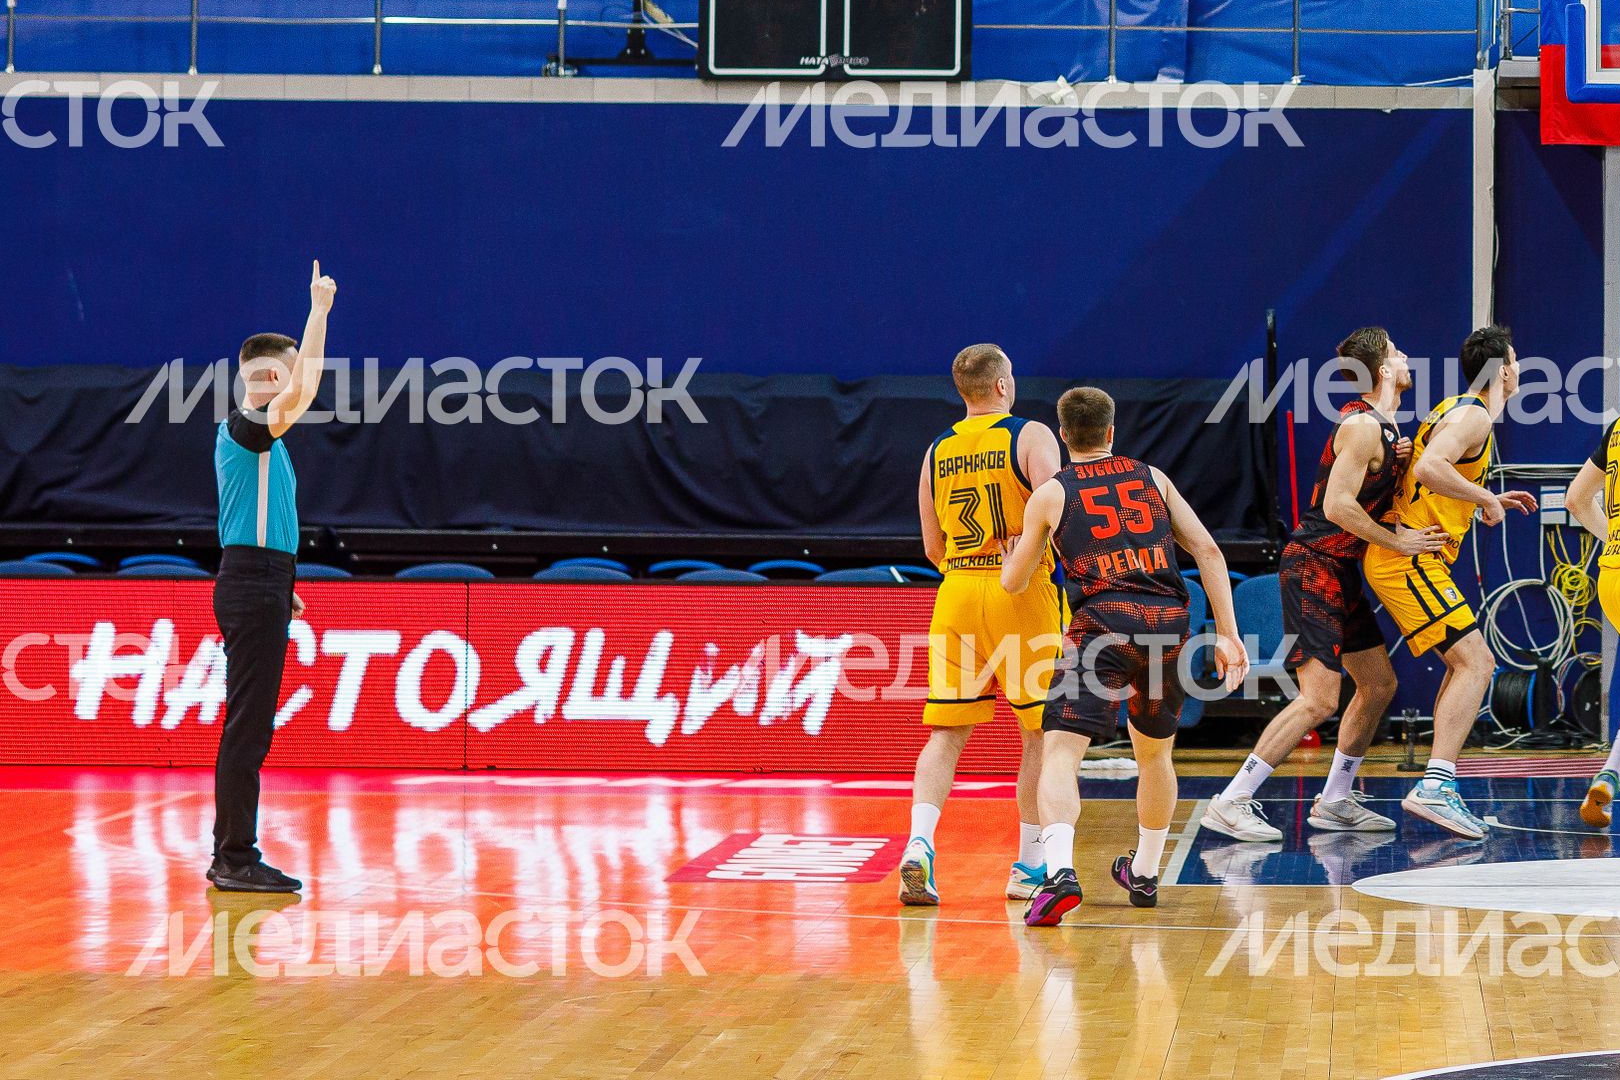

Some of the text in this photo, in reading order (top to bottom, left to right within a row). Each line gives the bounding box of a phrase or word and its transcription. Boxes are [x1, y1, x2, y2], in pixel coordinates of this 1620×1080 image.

[938, 450, 1006, 479] ВАРНАКОВ
[948, 482, 1008, 551] 31
[1078, 479, 1155, 540] 55
[946, 553, 1003, 570] МОСКОВС
[1096, 546, 1169, 580] РЕВДА
